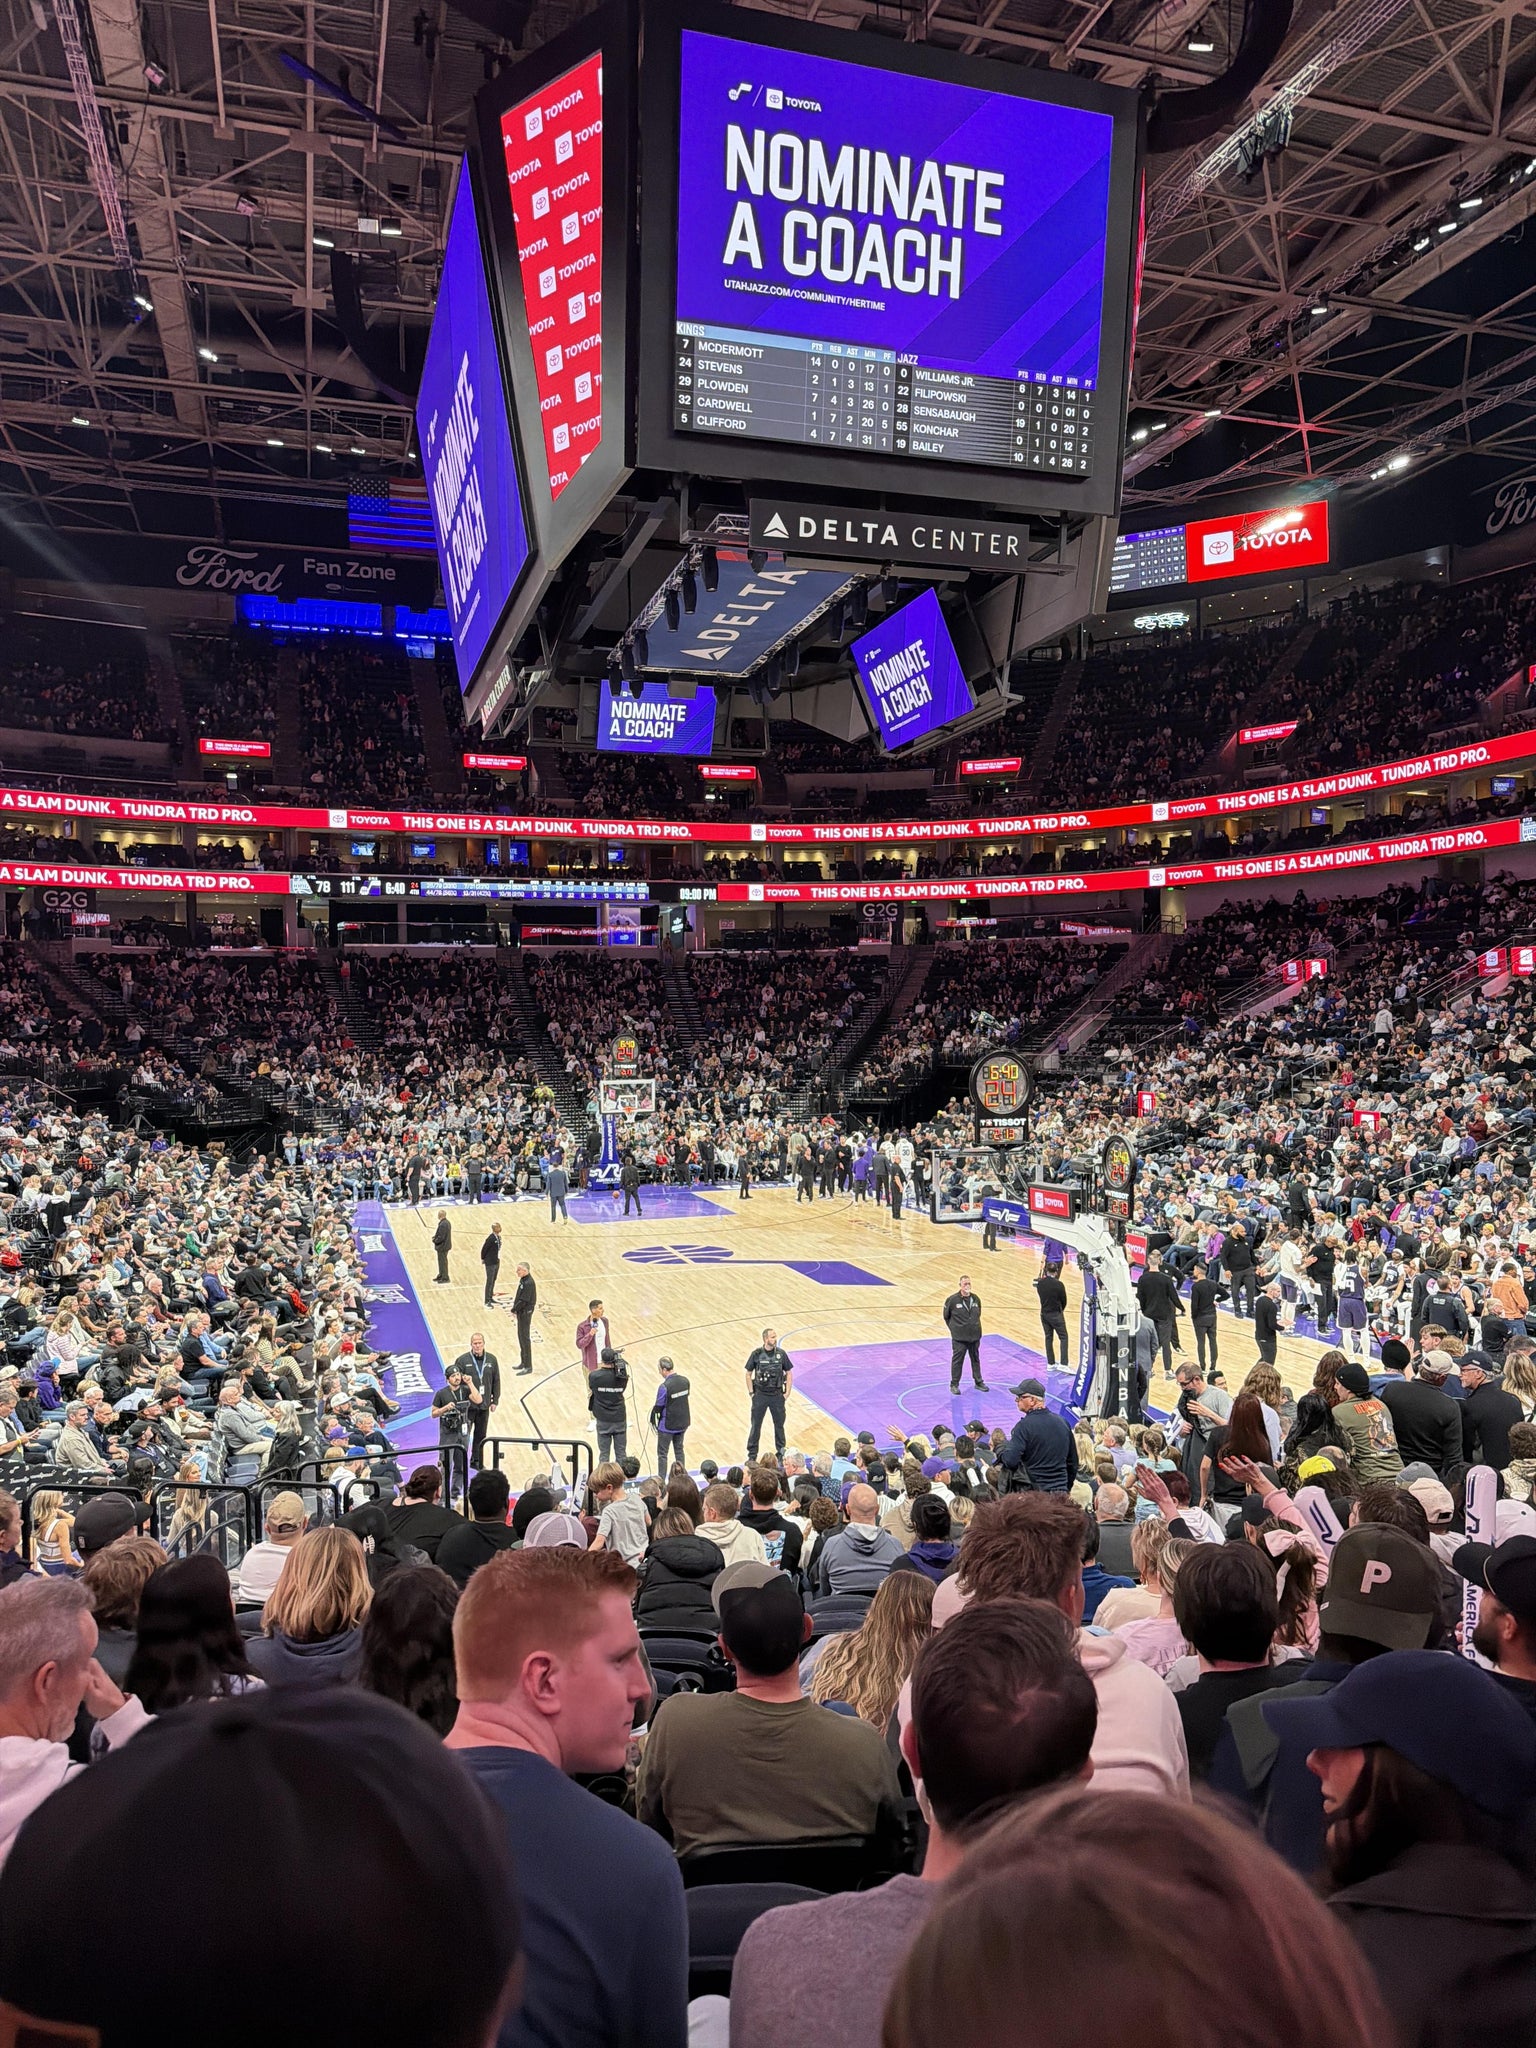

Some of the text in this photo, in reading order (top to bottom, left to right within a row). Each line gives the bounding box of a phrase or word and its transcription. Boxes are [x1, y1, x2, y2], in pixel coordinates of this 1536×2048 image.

[545, 90, 583, 120] TOYOTA
[786, 97, 821, 111] TOYOTA
[552, 172, 590, 200] TOYOTA
[726, 124, 1004, 236] NOMINATE
[723, 201, 962, 300] A COACH
[558, 253, 596, 280] TOYOTA
[725, 278, 886, 310] UTAHJAZZ.COM/COMMUNITY/HERTIME
[677, 323, 705, 336] KINGS
[699, 341, 874, 373] MCDERMOTT 14 17
[898, 354, 918, 365] JAZZ
[679, 357, 874, 391] 24 STEVENS 13
[901, 369, 1089, 401] 0 WILLIAMS JR. 6 7 3 14 1
[679, 376, 874, 409] 29 PLOWDEN 26
[898, 386, 1075, 416] 22 FILIPOWSKI 01
[679, 395, 873, 427] 32 CARDWELL 20
[897, 404, 1074, 434] 28 SENSABAUGH 19 20
[697, 416, 871, 444] CLIFFORD 31
[897, 421, 1072, 451] 55 KONCHAR 12
[433, 350, 480, 548] NOMINATE
[896, 439, 1072, 467] 19 BAILEY 10 26
[452, 464, 488, 593] COACH
[799, 517, 1018, 556] DELTA CENTER
[1241, 527, 1312, 552] TOYOTA
[176, 546, 285, 593] Ford
[303, 558, 396, 580] Fan Zone
[446, 551, 462, 622] A
[697, 570, 808, 641] DELTA
[869, 639, 930, 697] NOMINATE
[611, 701, 686, 722] NOMINATE
[881, 697, 893, 723] A
[890, 674, 932, 717] COACH
[610, 719, 674, 739] A COACH
[1218, 747, 1490, 810] THIS ONE IS A SLAM DUNK. TUNDRA TRD PRO.
[2, 794, 256, 822] A SLAM DUNK. TUNDRA TRD PRO.
[350, 815, 390, 824] TOYOTA
[1172, 803, 1206, 814] TOYOTA
[403, 817, 691, 836] THIS ONE IS A SLAM DUNK. TUNDRA TRD PRO.
[769, 829, 802, 837] TOYOTA
[813, 815, 1090, 838] THIS ONE IS A SLAM DUNK. TUNDRA TRD PRO.
[1215, 831, 1487, 877] THIS ONE IS A SLAM DUNK. TUNDRA TRD PRO.
[0, 868, 254, 889] A SLAM DUNK. TUNDRA TRD PRO.
[316, 881, 330, 893] 78
[341, 881, 355, 893] 111
[386, 882, 405, 894] 6:40
[811, 878, 1087, 897] THIS ONE IS A SLAM DUNK. TUNDRA TRD PRO.
[1168, 870, 1203, 879] TOYOTA
[43, 890, 88, 908] G2G
[680, 888, 716, 900] 09:00 PM
[862, 903, 898, 918] G2G
[617, 1048, 634, 1061] 24
[990, 1065, 1019, 1080] 6:40
[985, 1081, 1016, 1107] 24
[993, 1118, 1026, 1126] TISSOT
[1111, 1164, 1126, 1182] 24
[1044, 1197, 1064, 1208] TOYOTA
[1076, 1336, 1090, 1396] AMERICA
[1118, 1368, 1128, 1420] NBA
[1360, 1559, 1392, 1594] P
[1465, 1580, 1476, 1646] AMERICA
